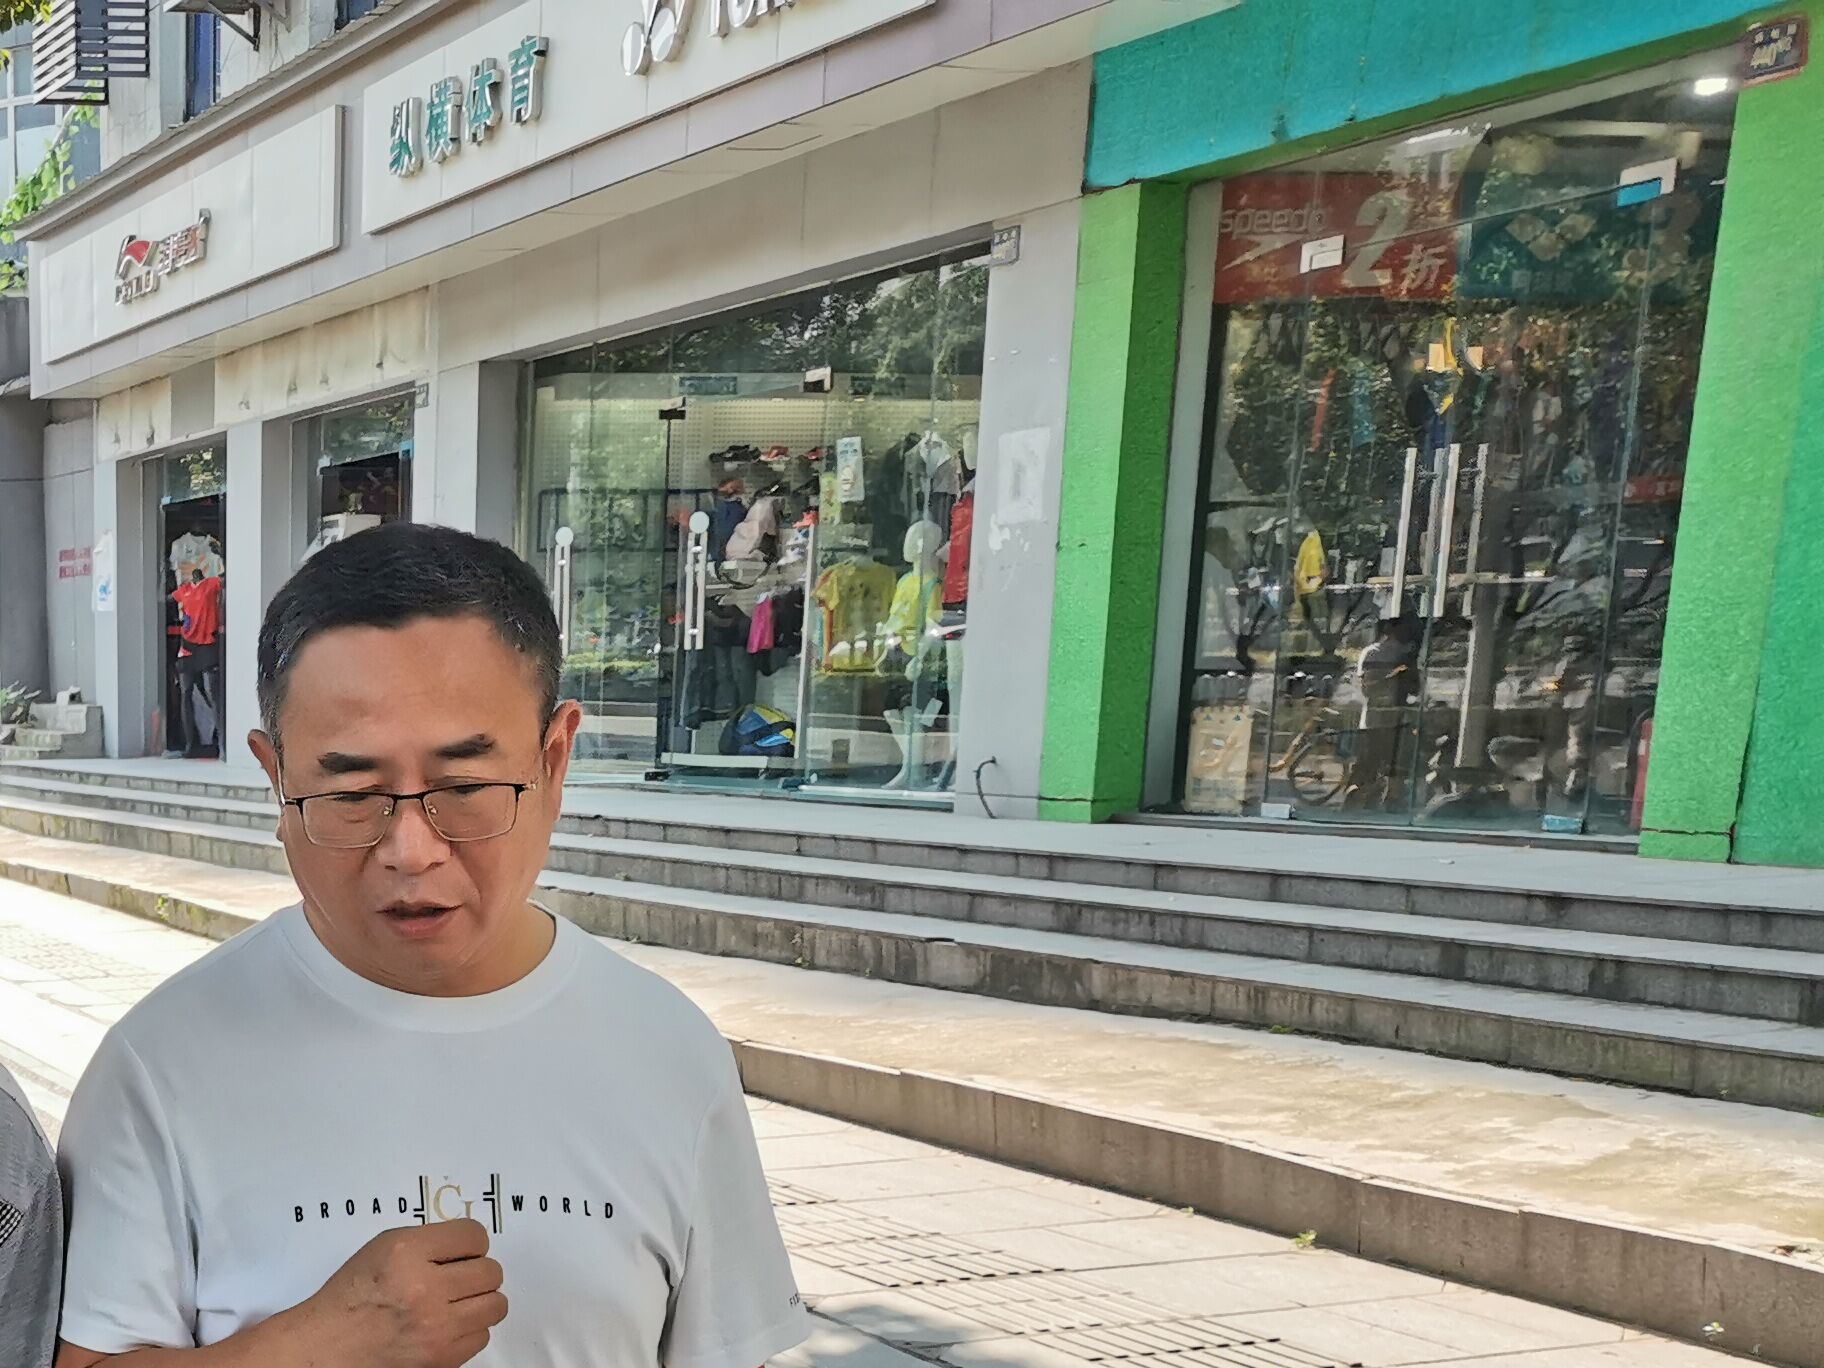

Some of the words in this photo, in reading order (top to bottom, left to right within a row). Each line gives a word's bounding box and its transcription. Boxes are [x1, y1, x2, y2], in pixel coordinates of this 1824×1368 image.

[389, 35, 549, 178] 纵横体育
[1220, 203, 1328, 238] speedo
[294, 1197, 408, 1222] BROAD
[512, 1194, 614, 1219] WORLD
